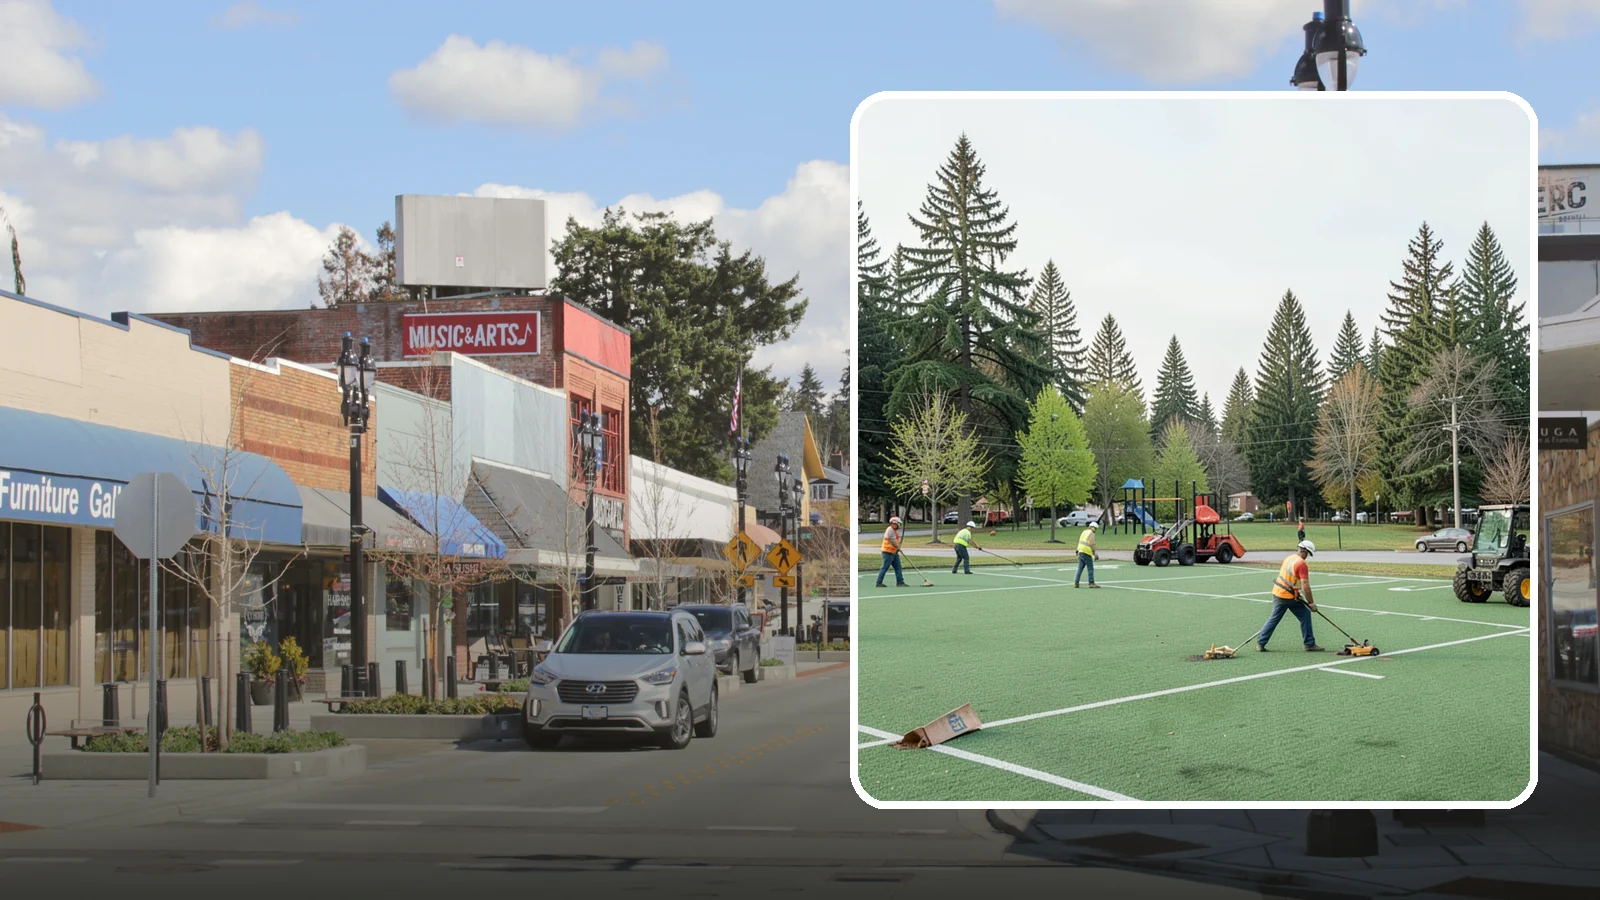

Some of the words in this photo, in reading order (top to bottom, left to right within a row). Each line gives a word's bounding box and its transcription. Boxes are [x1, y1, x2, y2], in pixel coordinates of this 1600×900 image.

[1540, 427, 1577, 436] UGA
[0, 472, 79, 515] Furniture
[89, 482, 121, 519] Gal
